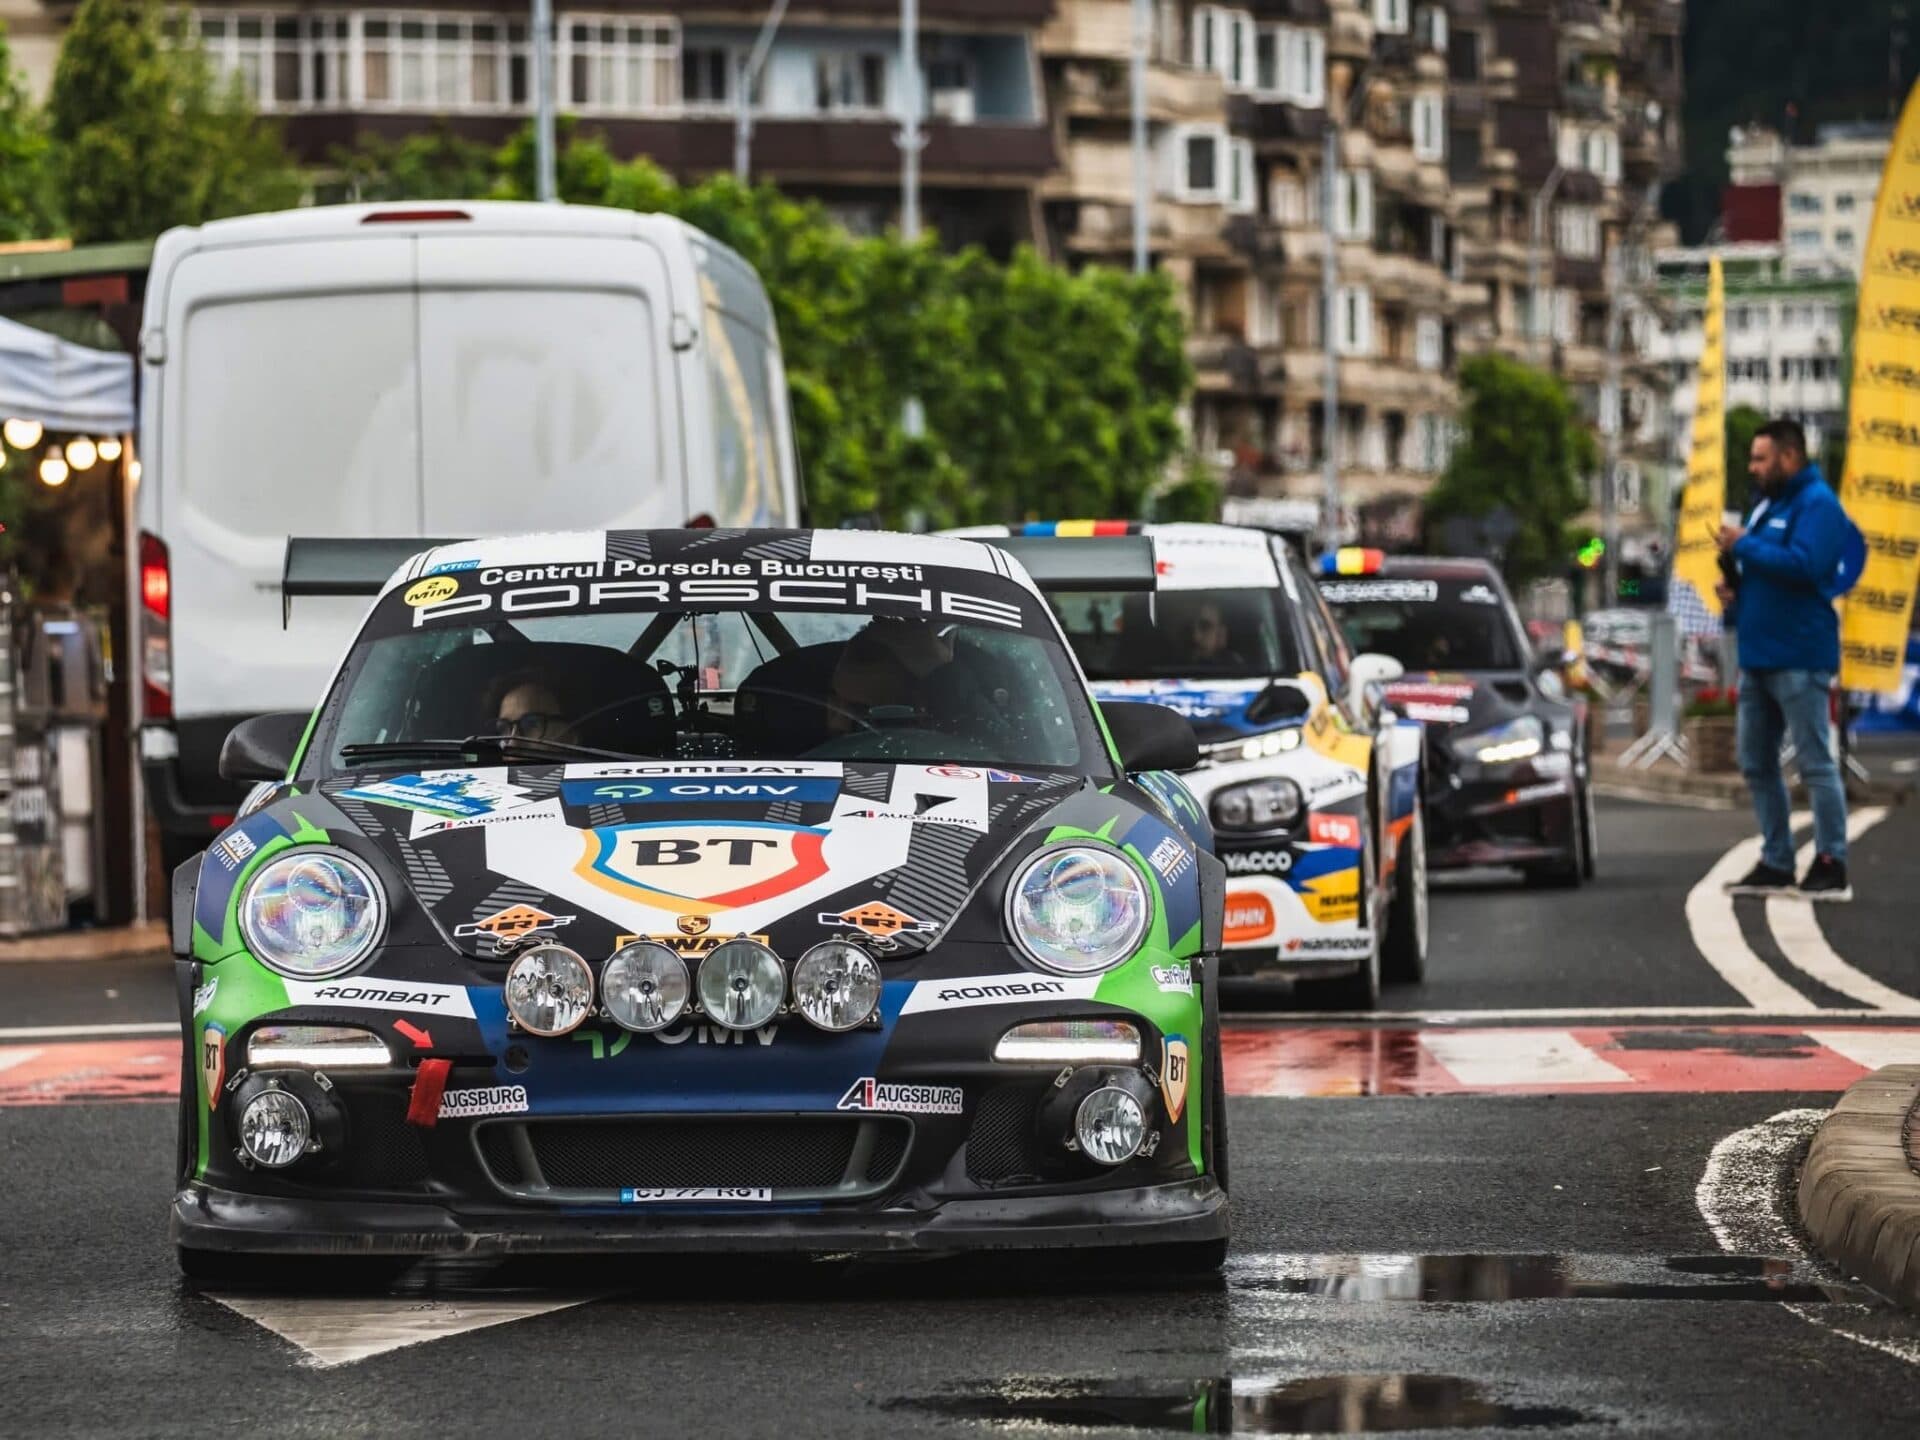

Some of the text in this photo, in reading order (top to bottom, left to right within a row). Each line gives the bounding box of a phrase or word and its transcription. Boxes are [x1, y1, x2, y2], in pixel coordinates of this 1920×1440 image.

[480, 560, 923, 586] Centrul Porsche București
[408, 587, 453, 602] MIN
[427, 581, 440, 589] 2
[412, 578, 1022, 629] PORSCHE
[594, 766, 814, 775] ROMBAT
[669, 784, 799, 795] OMV
[457, 813, 556, 826] AUGSBURG
[878, 811, 977, 825] AUGSBURG
[631, 839, 778, 867] BT
[1223, 852, 1292, 872] YACCO
[314, 986, 451, 1006] ROMBAT
[937, 981, 1066, 1002] ROMBAT
[205, 1043, 219, 1071] BT
[1169, 1054, 1186, 1085] BT
[876, 1085, 961, 1104] AUGSBURG
[875, 1102, 962, 1113] INTERNATIONAL
